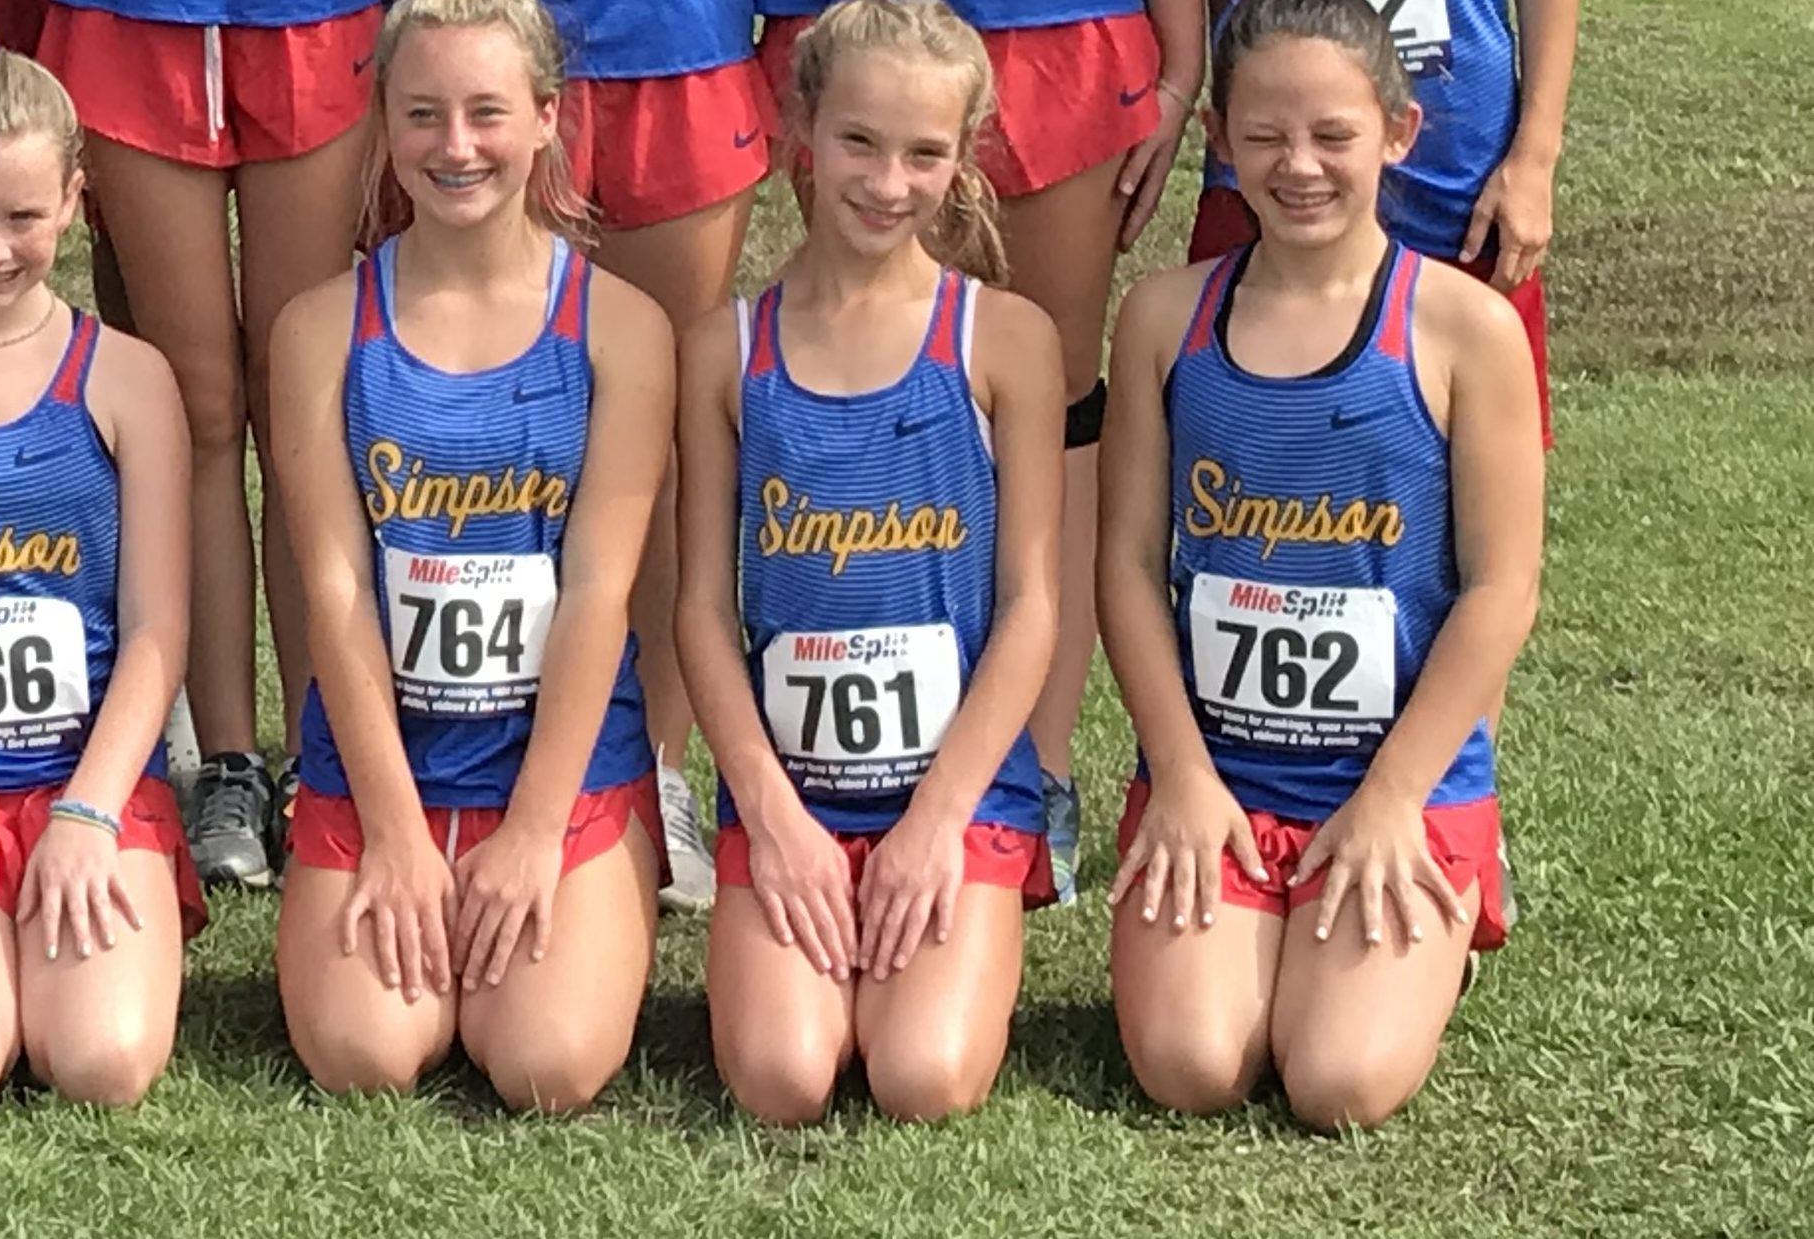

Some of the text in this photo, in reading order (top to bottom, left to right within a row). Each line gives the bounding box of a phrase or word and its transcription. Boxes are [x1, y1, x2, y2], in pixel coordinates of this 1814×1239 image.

[366, 440, 568, 539] Simpson
[758, 476, 969, 576] Simpson
[1186, 458, 1405, 561] Simpson
[408, 557, 515, 589] MileSplit
[1228, 582, 1348, 621] MileSplit
[399, 593, 524, 678] 764
[794, 634, 909, 665] MileSplit
[1216, 620, 1359, 712] 762
[786, 670, 922, 755] 761
